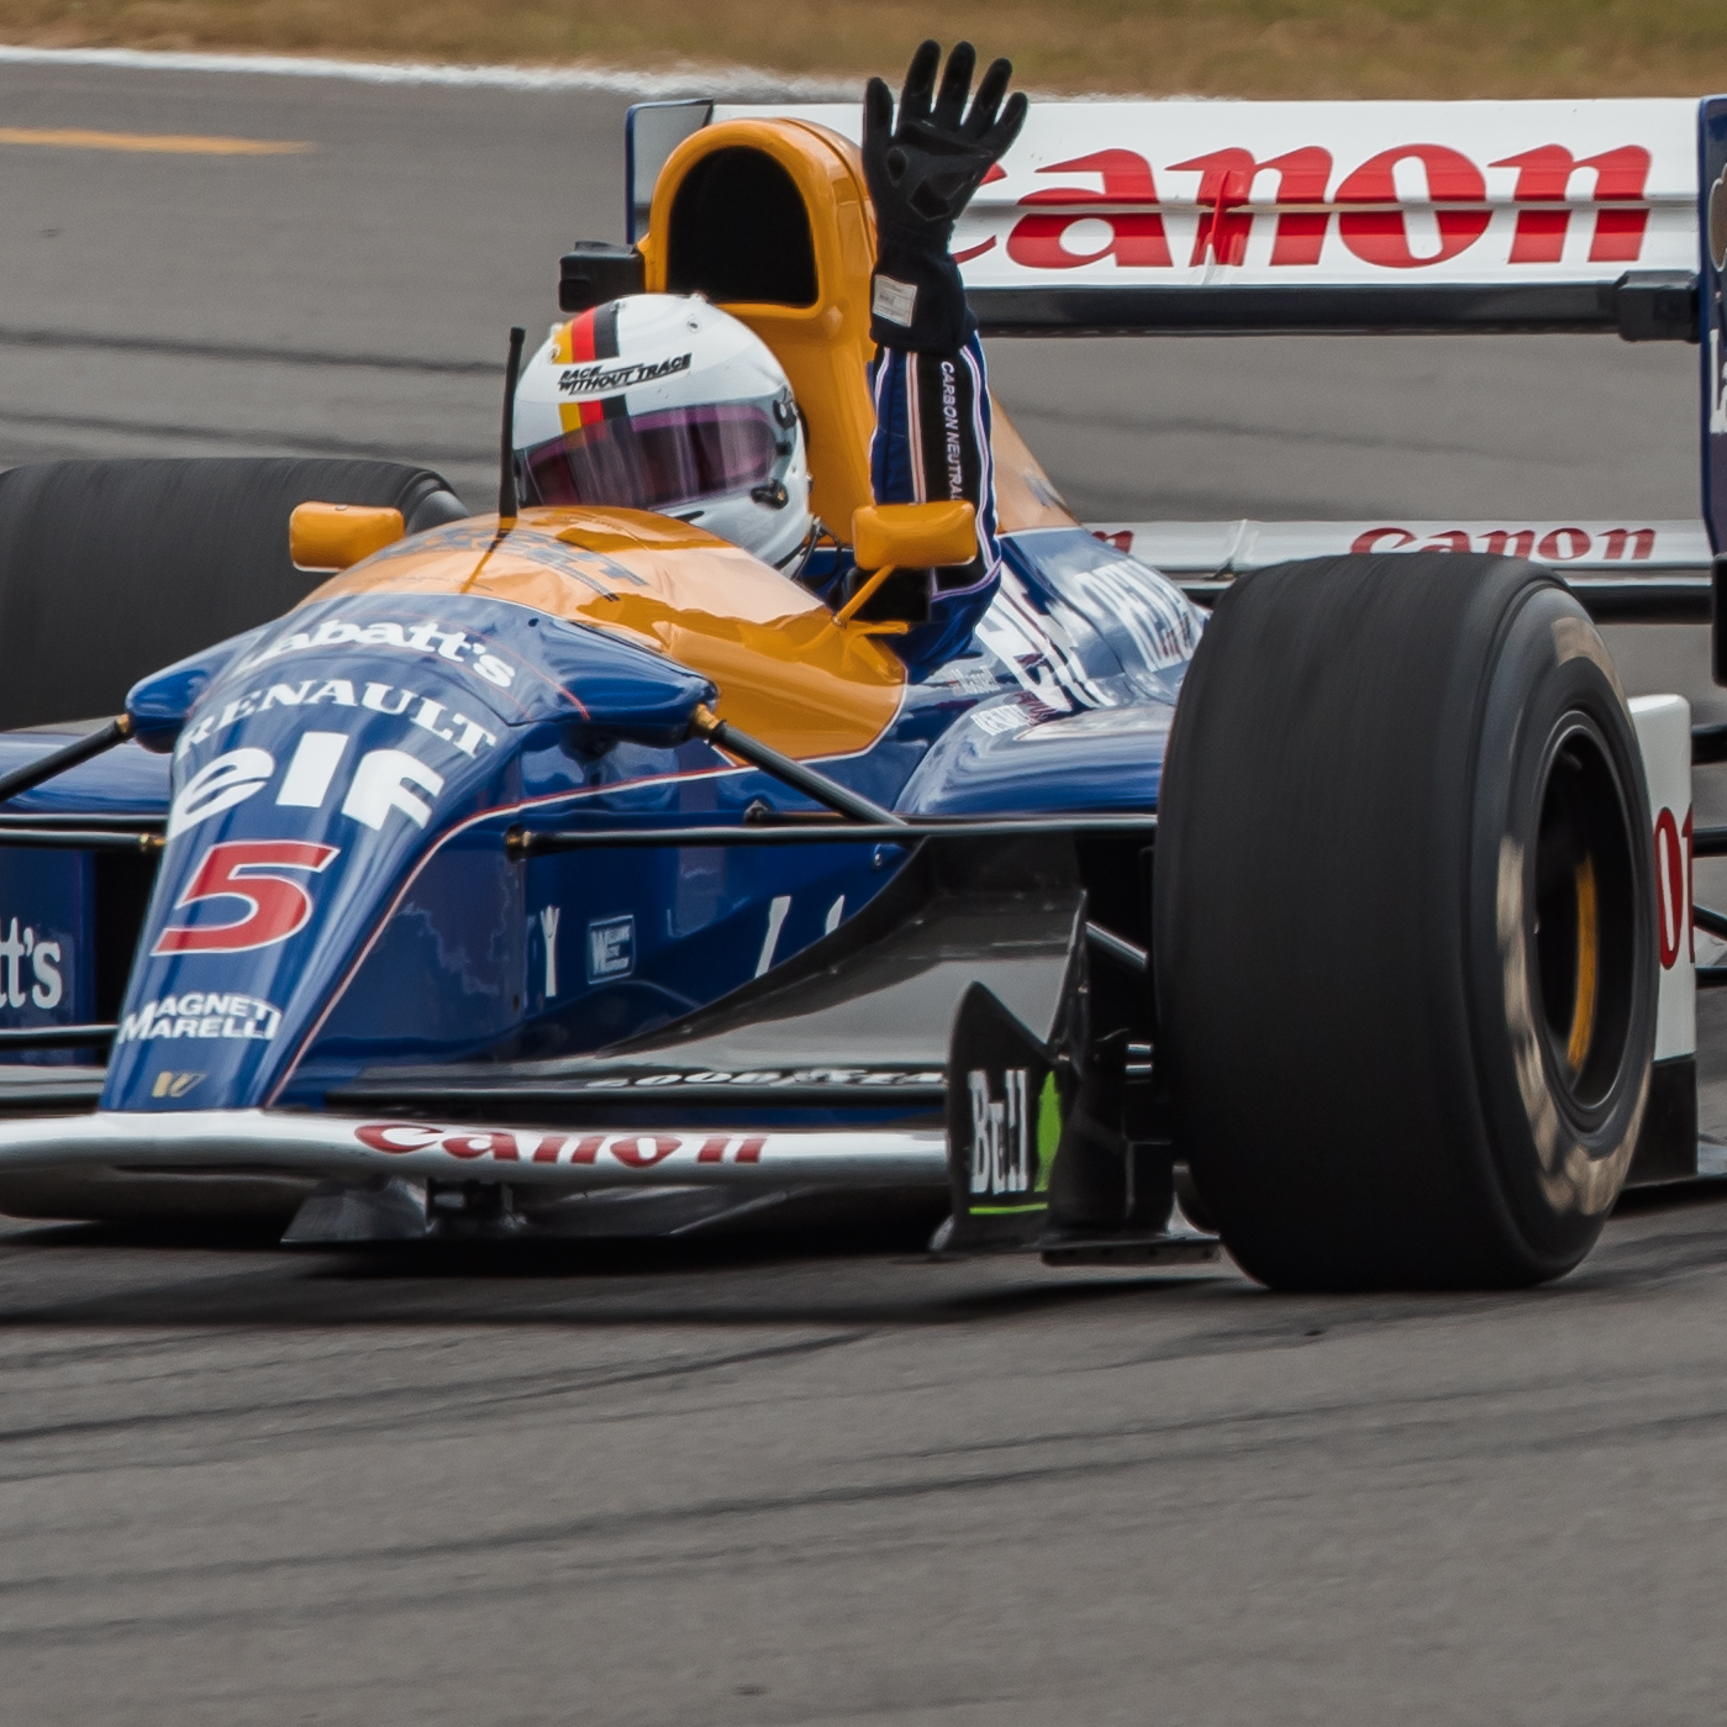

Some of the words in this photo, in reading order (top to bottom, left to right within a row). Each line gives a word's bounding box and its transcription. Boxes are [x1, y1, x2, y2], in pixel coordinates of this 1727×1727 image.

[558, 370, 635, 392] WITHOUT
[636, 352, 692, 381] TRACE
[560, 365, 603, 380] RACE
[940, 361, 959, 429] CARBON
[1350, 527, 1656, 560] Canon
[173, 678, 498, 761] RENAULT
[166, 731, 445, 844] elf
[149, 838, 342, 957] 5
[584, 1069, 947, 1091] GOODYEA
[354, 1123, 769, 1171] Canon
